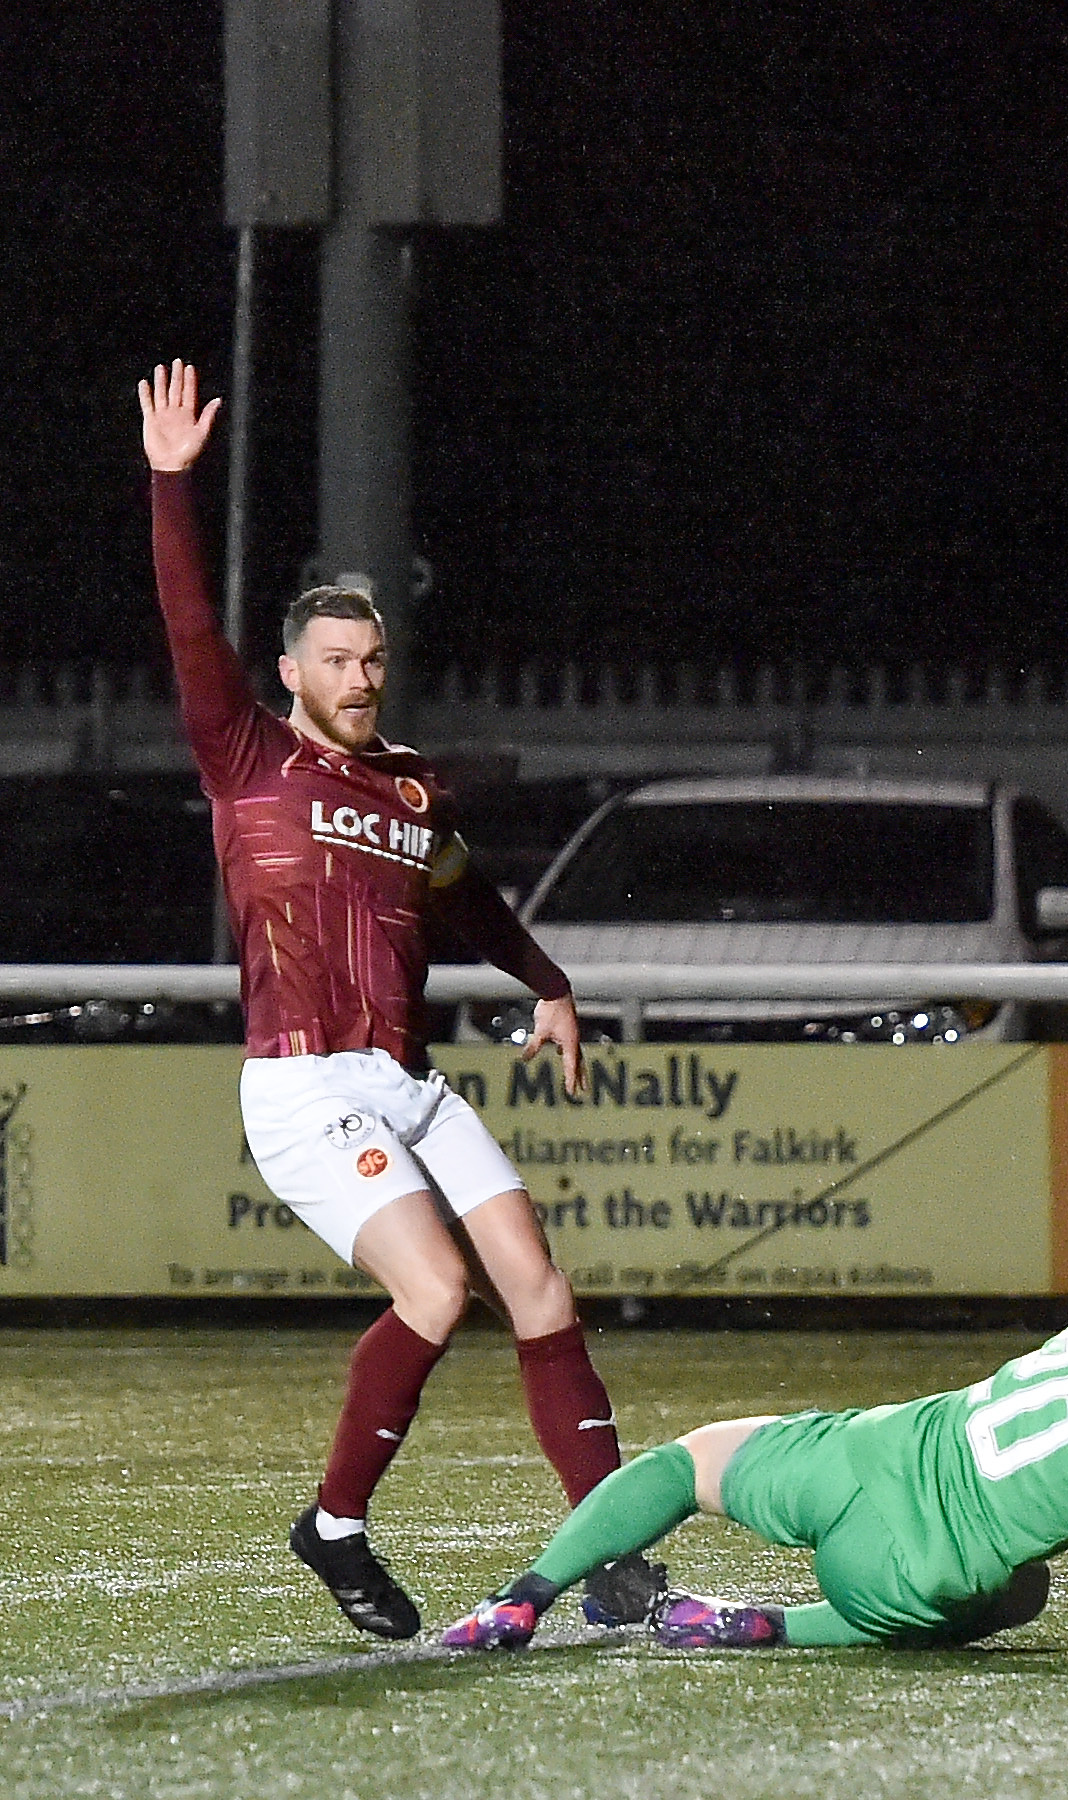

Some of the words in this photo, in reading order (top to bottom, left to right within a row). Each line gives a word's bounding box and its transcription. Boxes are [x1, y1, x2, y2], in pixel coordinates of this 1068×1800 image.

[311, 800, 381, 845] LOC
[503, 1126, 656, 1164] liament
[669, 1125, 723, 1164] for
[733, 1126, 857, 1164] Falkirk
[228, 1192, 294, 1228] Pro
[605, 1187, 673, 1229] the
[685, 1189, 873, 1229] Warriors
